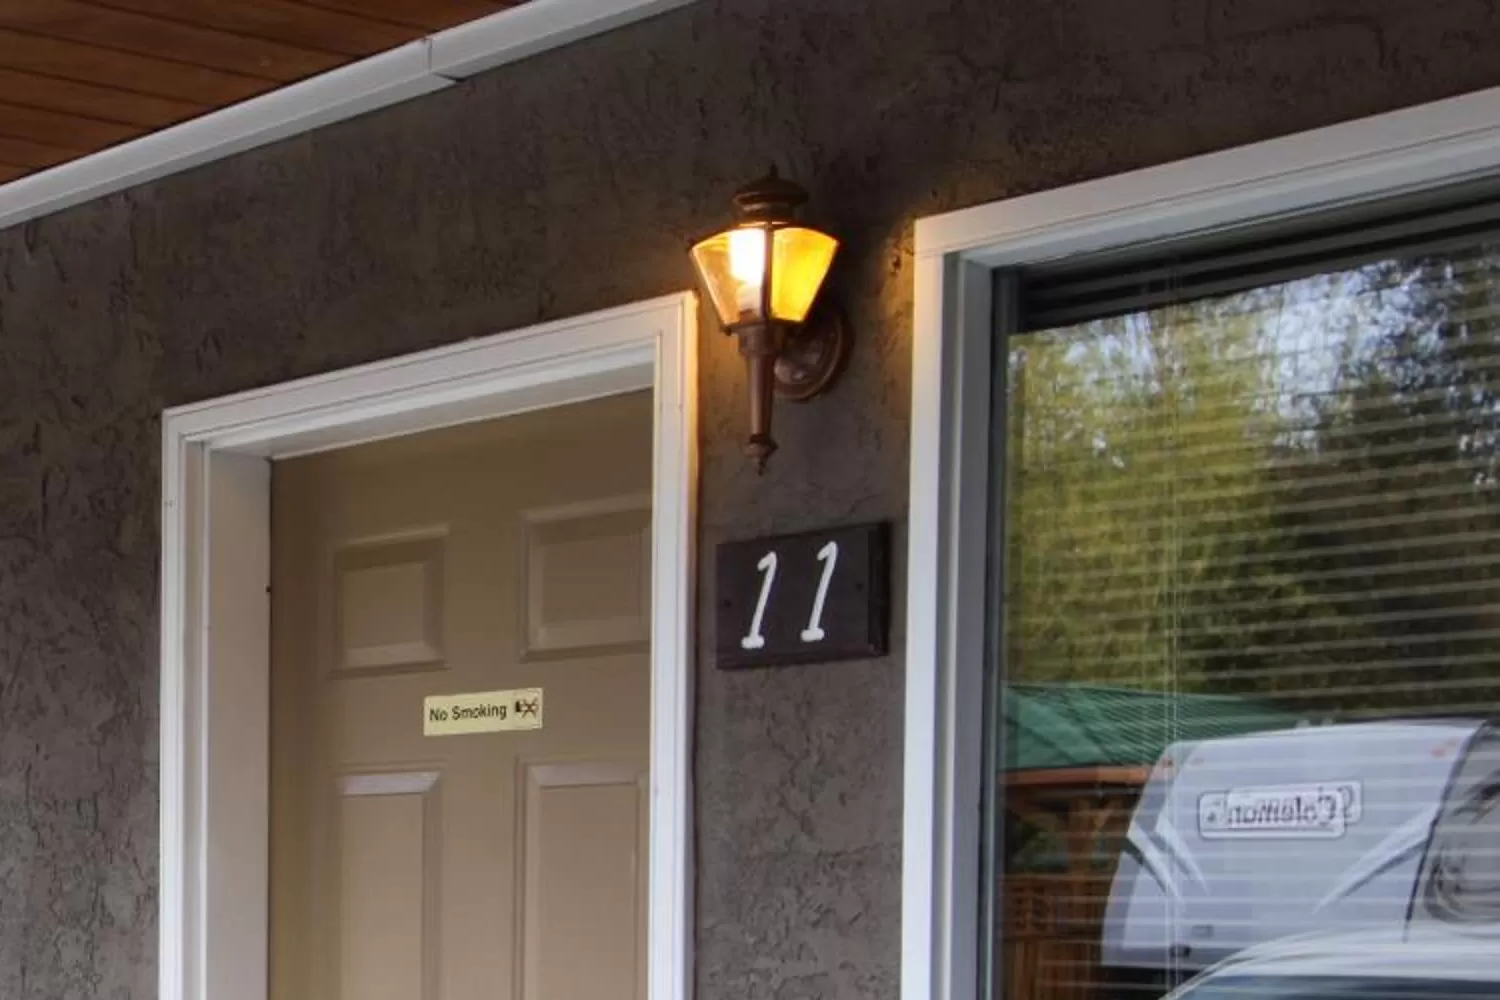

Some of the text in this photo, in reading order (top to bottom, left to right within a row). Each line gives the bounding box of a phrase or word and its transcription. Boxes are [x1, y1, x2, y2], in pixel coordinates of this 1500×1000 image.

[740, 540, 838, 649] 11
[428, 703, 508, 722] No Smoking
